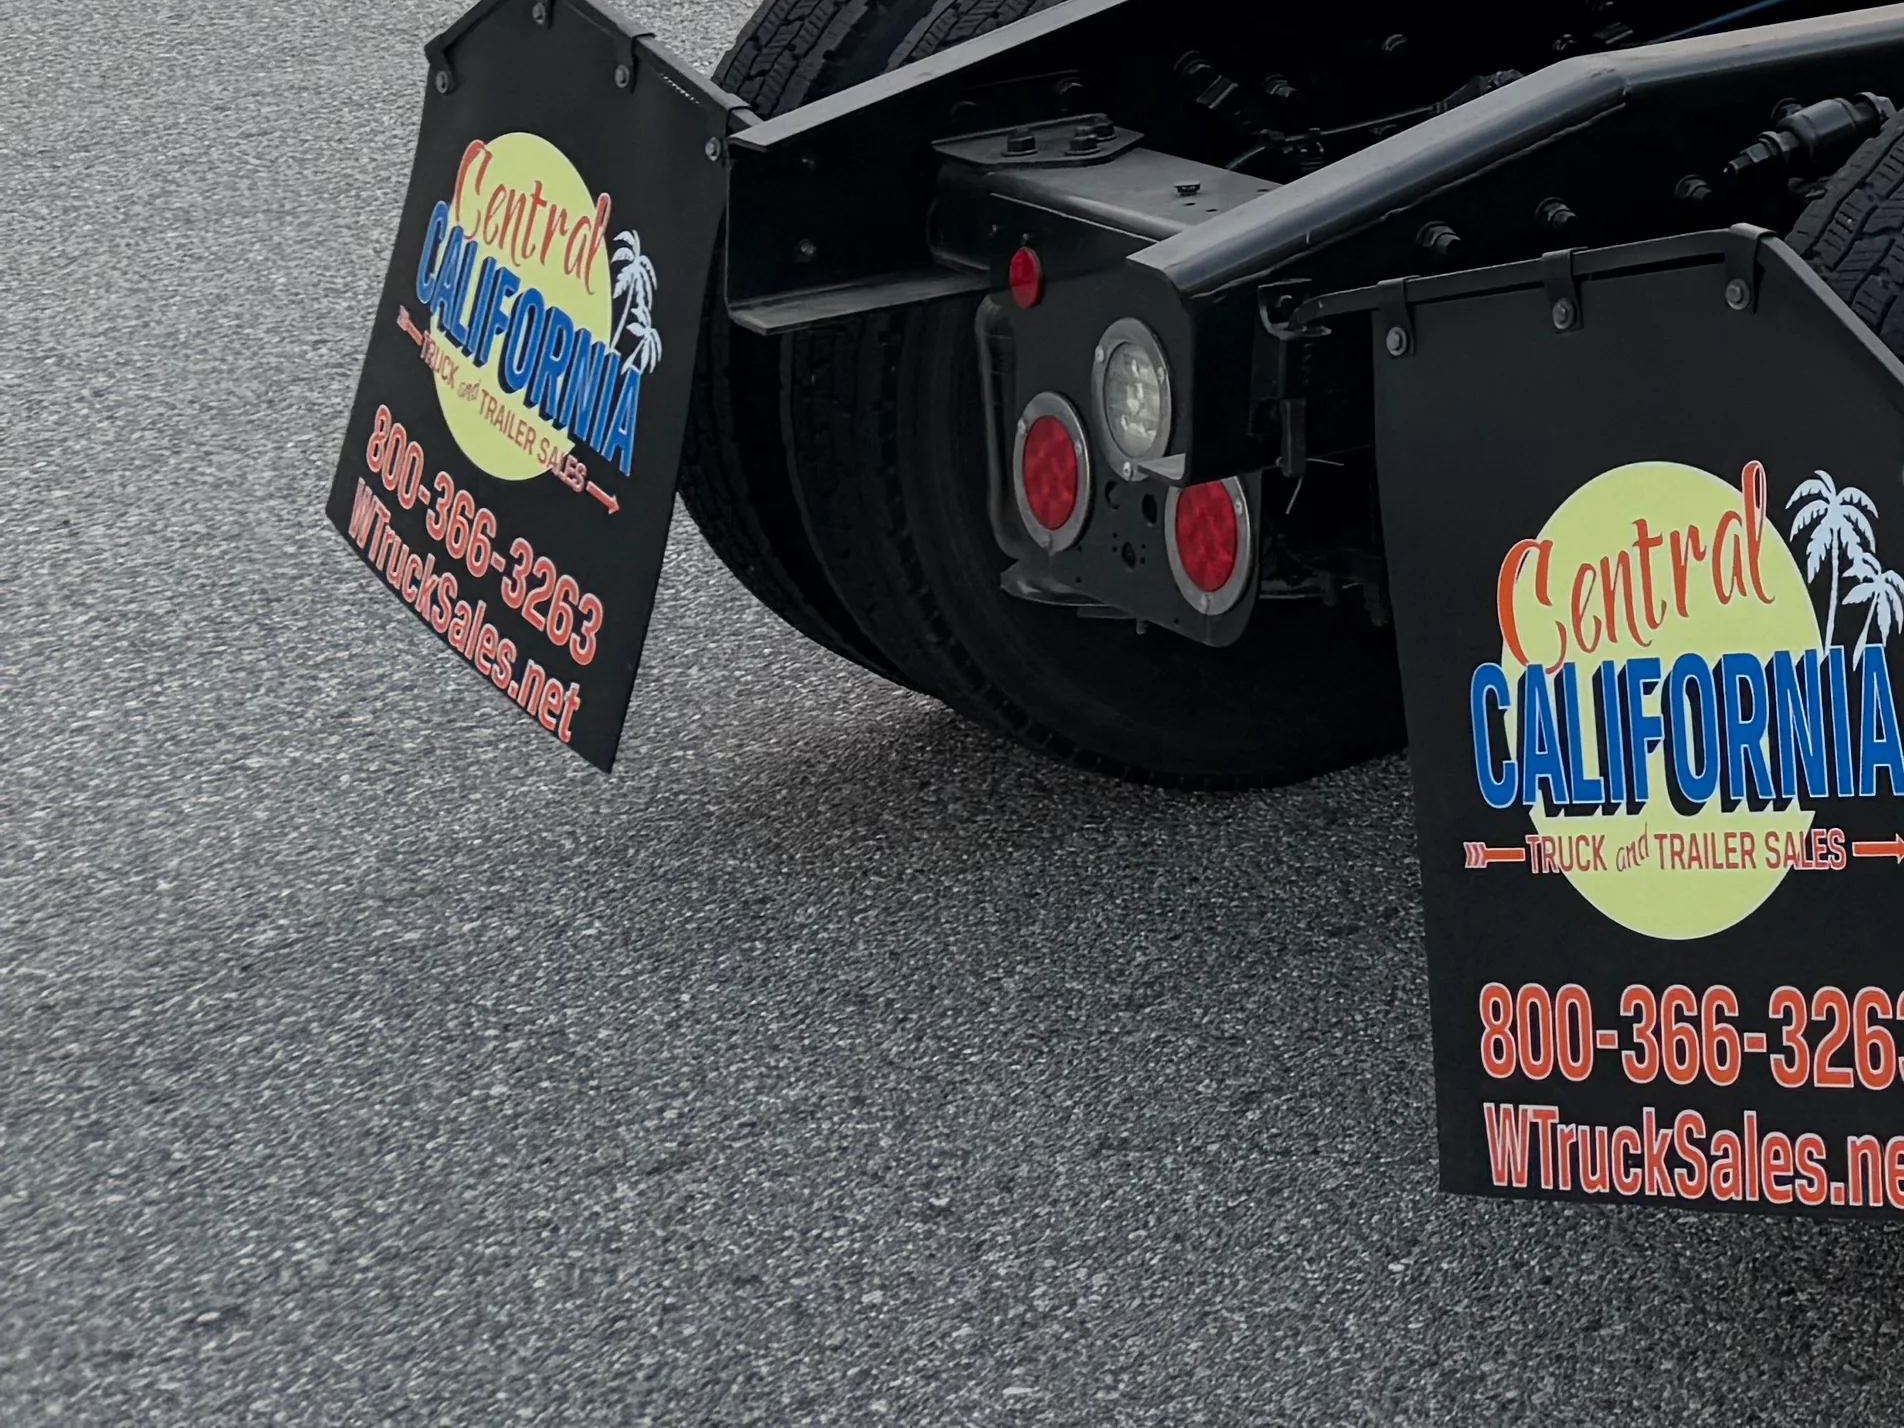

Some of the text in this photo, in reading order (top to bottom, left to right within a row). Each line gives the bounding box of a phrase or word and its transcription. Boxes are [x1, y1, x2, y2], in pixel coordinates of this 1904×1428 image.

[453, 139, 612, 295] Central
[415, 200, 642, 477] CALIFORNIA
[420, 330, 588, 494] TRUCK and TRAILER SALES
[348, 477, 581, 743] WTruckSales.net
[366, 404, 604, 666] 800-366-3263
[1497, 460, 1776, 674] Central
[1525, 822, 1847, 875] TRUCK and TRAILER SALES
